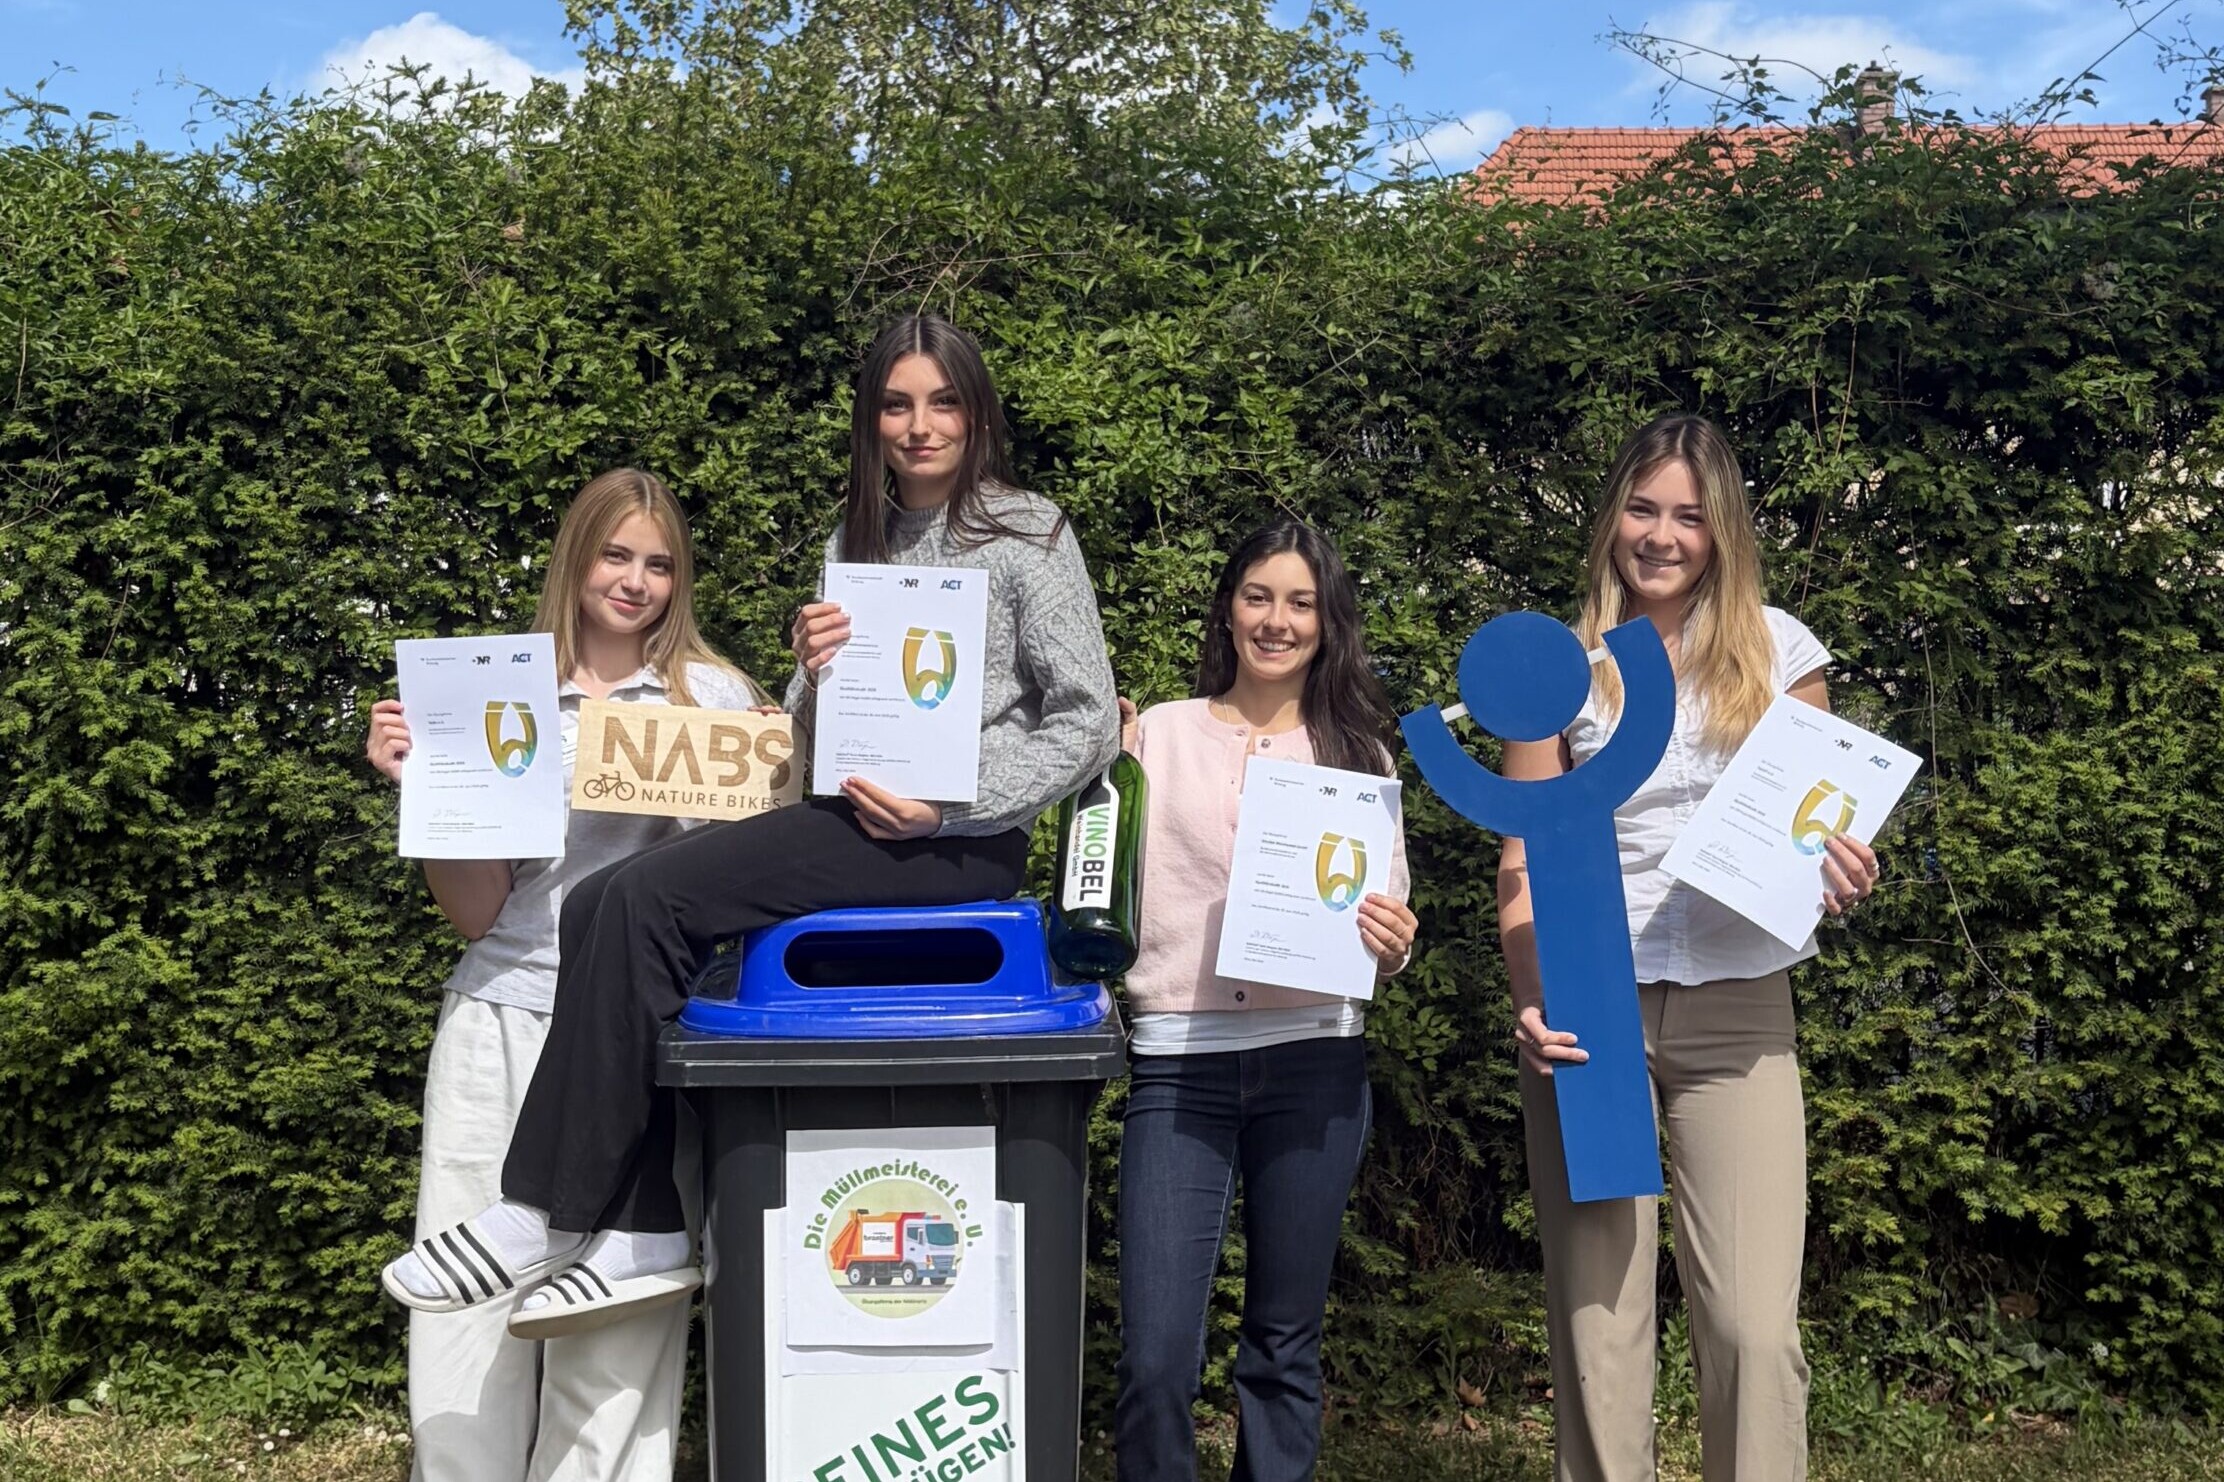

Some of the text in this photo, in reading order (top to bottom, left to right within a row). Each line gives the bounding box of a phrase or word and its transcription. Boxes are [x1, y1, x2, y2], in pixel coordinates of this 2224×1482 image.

[940, 579, 962, 590] ACT
[511, 653, 532, 663] ACT
[602, 716, 793, 790] NABS
[1868, 755, 1892, 770] ACT
[641, 788, 781, 810] NATURE BIKES
[1356, 792, 1378, 804] ACT
[1079, 806, 1111, 902] VINOBEL
[803, 1213, 828, 1250] Die
[821, 1159, 959, 1208] Müllmeisterei
